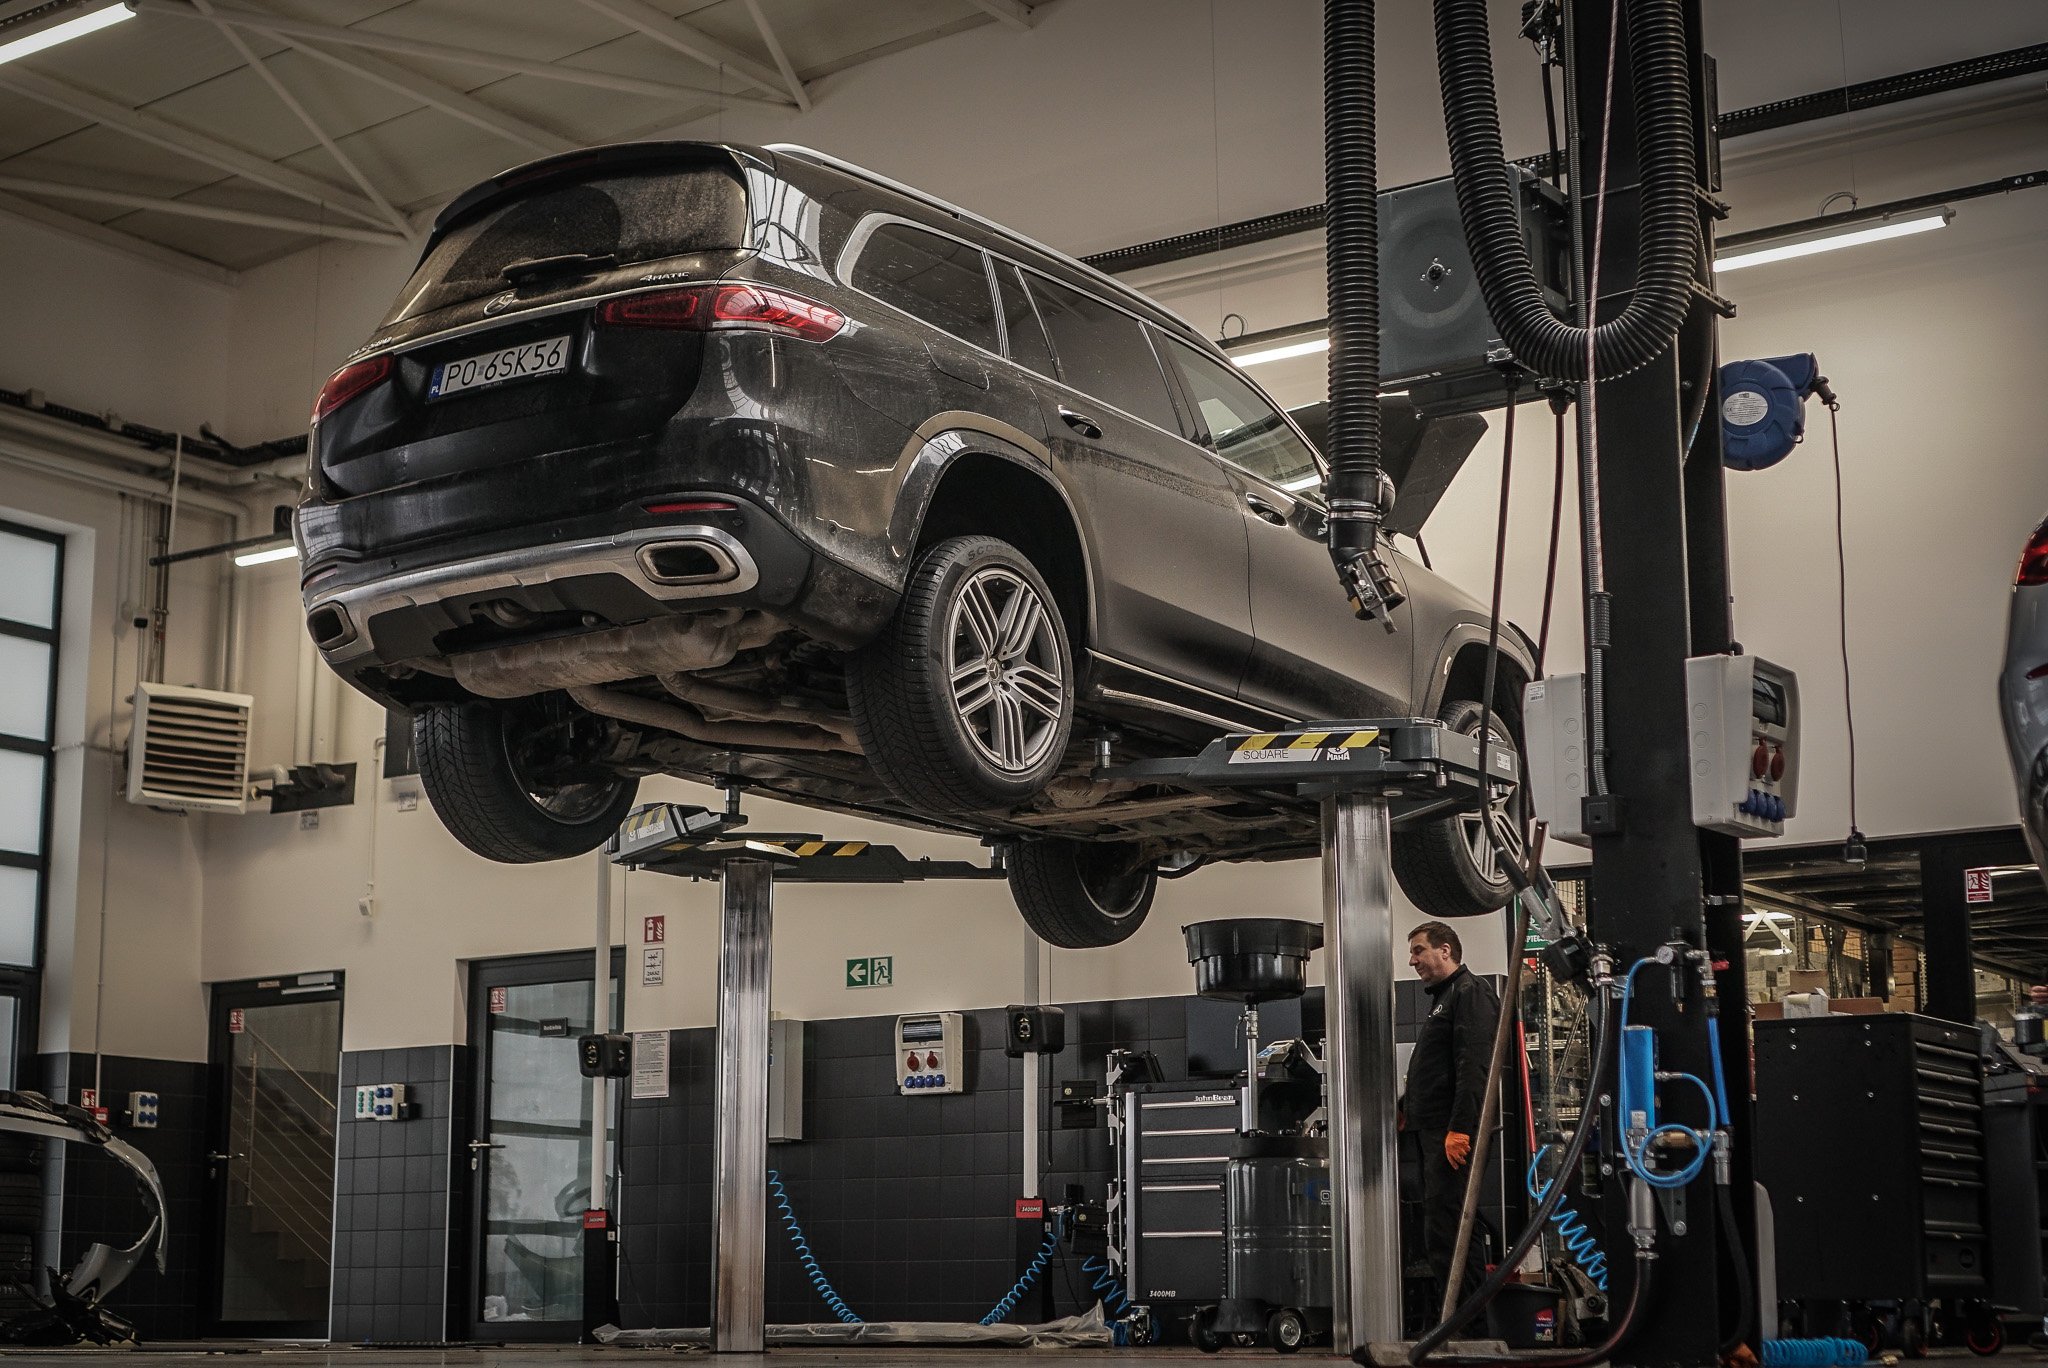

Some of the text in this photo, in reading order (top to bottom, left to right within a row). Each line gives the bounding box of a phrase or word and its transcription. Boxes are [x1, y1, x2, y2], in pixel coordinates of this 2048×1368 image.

[640, 271, 690, 282] 4MATIC
[444, 339, 564, 392] PO 6SK56
[430, 385, 439, 394] PL
[1242, 749, 1289, 761] SQUARE
[1326, 752, 1351, 761] MAHA
